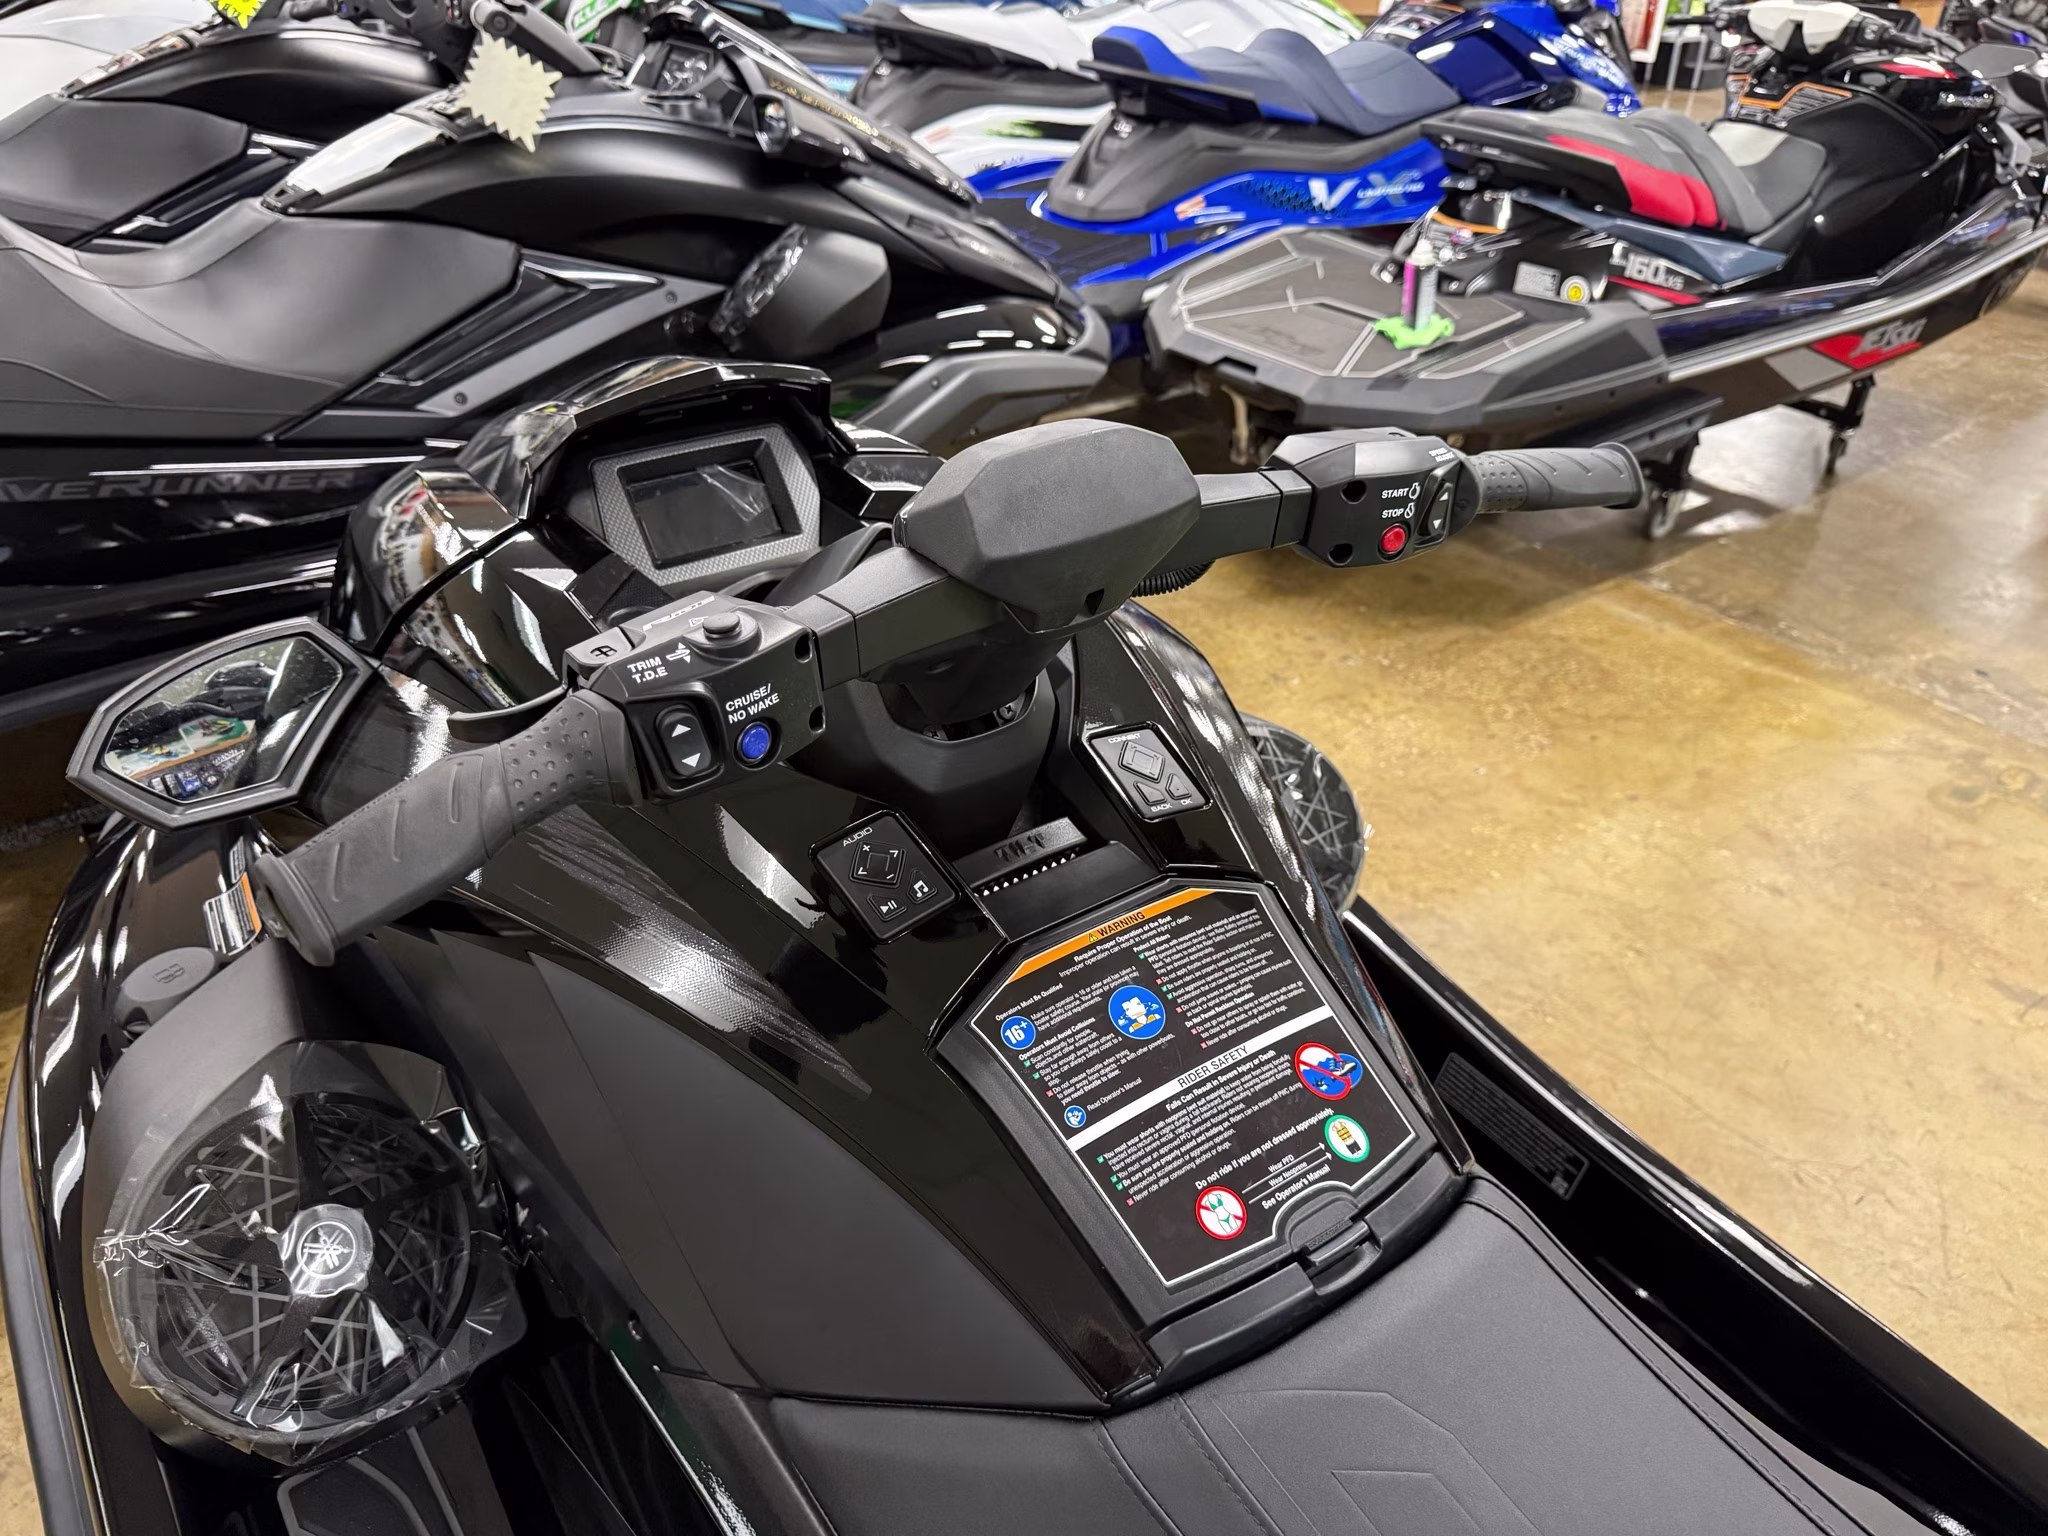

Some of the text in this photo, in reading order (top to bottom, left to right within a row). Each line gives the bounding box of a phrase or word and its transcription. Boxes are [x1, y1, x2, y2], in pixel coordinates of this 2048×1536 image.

[0, 471, 355, 500] VERUNNER
[1381, 488, 1409, 499] START
[1381, 508, 1404, 518] STOP
[627, 657, 662, 673] TRIM
[632, 666, 668, 683] T.D.E
[725, 683, 771, 712] CRUISE/
[728, 693, 780, 724] NO WAKE
[1151, 803, 1173, 812] BACK
[843, 826, 873, 847] AUDIO
[1072, 947, 1098, 962] Require
[1095, 939, 1117, 952] Proper
[1115, 927, 1144, 943] Operation
[1148, 920, 1159, 928] the
[1157, 914, 1172, 924] Boat
[1096, 910, 1145, 937] WARNING
[1057, 961, 1086, 978] Improper
[1083, 950, 1111, 966] operation
[1109, 945, 1121, 955] can
[1119, 938, 1136, 950] result
[1139, 928, 1158, 941] severe
[1156, 922, 1172, 933] injury
[1175, 913, 1192, 925] death.
[994, 1004, 1022, 1021] Operators
[1019, 997, 1035, 1008] Must
[1040, 982, 1064, 998] Qualified
[1017, 1016, 1096, 1061] Operators Must Avoid Collisions
[1029, 1053, 1044, 1063] Scan
[1042, 1040, 1068, 1057] constantly
[1066, 1036, 1075, 1044] for
[1038, 1065, 1052, 1076] Stay
[1057, 1052, 1077, 1066] enough
[1075, 1046, 1089, 1056] away
[1087, 1040, 1100, 1049] from
[1099, 1032, 1115, 1043] others
[1046, 1076, 1062, 1087] stop.
[1059, 1080, 1070, 1089] not
[1067, 1071, 1087, 1084] release
[1085, 1062, 1104, 1075] throttle
[1102, 1055, 1117, 1066] when
[1114, 1048, 1130, 1059] trying
[1165, 1098, 1182, 1111] Falls
[1179, 1092, 1195, 1103] Can
[1192, 1082, 1214, 1097] Result
[1217, 1068, 1239, 1084] Severe
[1236, 1060, 1254, 1074] Injury
[1258, 1049, 1276, 1062] Death
[1176, 1044, 1250, 1088] RIDER SAFETY
[1060, 1095, 1072, 1105] you
[1070, 1088, 1085, 1099] need
[1083, 1079, 1102, 1092] throttle
[1106, 1068, 1121, 1079] steer.
[1085, 1076, 1142, 1111] Read Operator's Manual
[1194, 1105, 1334, 1189] Do not ride if you are not dressed appropriately.
[1267, 1153, 1295, 1172] Wear PFD
[1132, 1189, 1149, 1202] Never
[1146, 1183, 1159, 1193] ride
[1157, 1176, 1171, 1187] after
[1168, 1161, 1196, 1181] consuming
[1193, 1151, 1213, 1166] alcohol
[1215, 1140, 1232, 1153] drugs.
[1261, 1163, 1331, 1209] See Operator's Manual
[1268, 1160, 1308, 1187] Wear Neoprene
